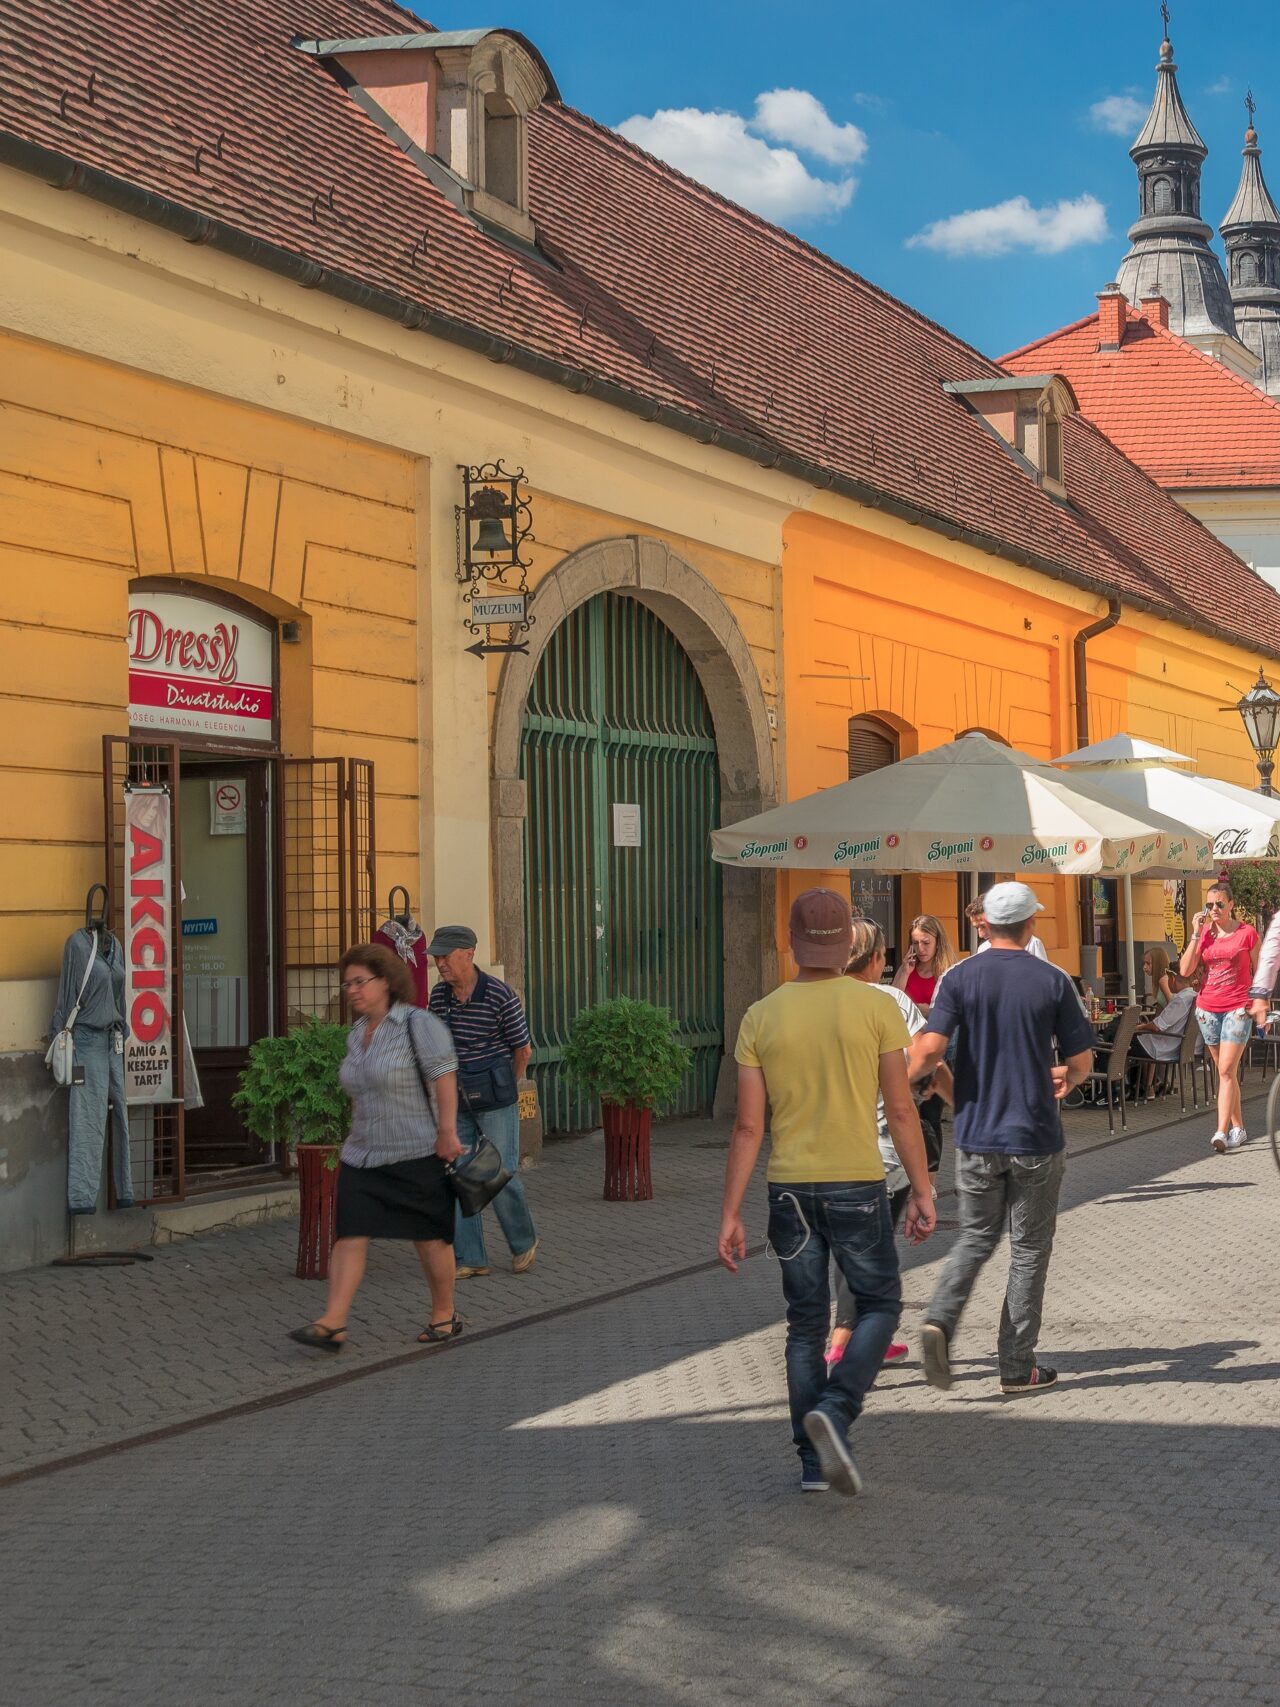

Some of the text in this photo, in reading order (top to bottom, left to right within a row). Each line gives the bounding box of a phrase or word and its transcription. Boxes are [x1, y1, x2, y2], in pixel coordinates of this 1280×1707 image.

[128, 609, 239, 684] Dressy
[167, 684, 261, 713] Divatstudió
[741, 838, 789, 860] Soproni
[833, 836, 881, 862] Soproni
[927, 838, 974, 862] Soproni
[1213, 828, 1253, 855] Cola
[1021, 842, 1068, 866] Soproni
[130, 823, 171, 1043] AKCIÓ
[184, 922, 215, 934] NYITVA
[160, 1045, 168, 1056] A
[134, 1073, 162, 1087] TART!
